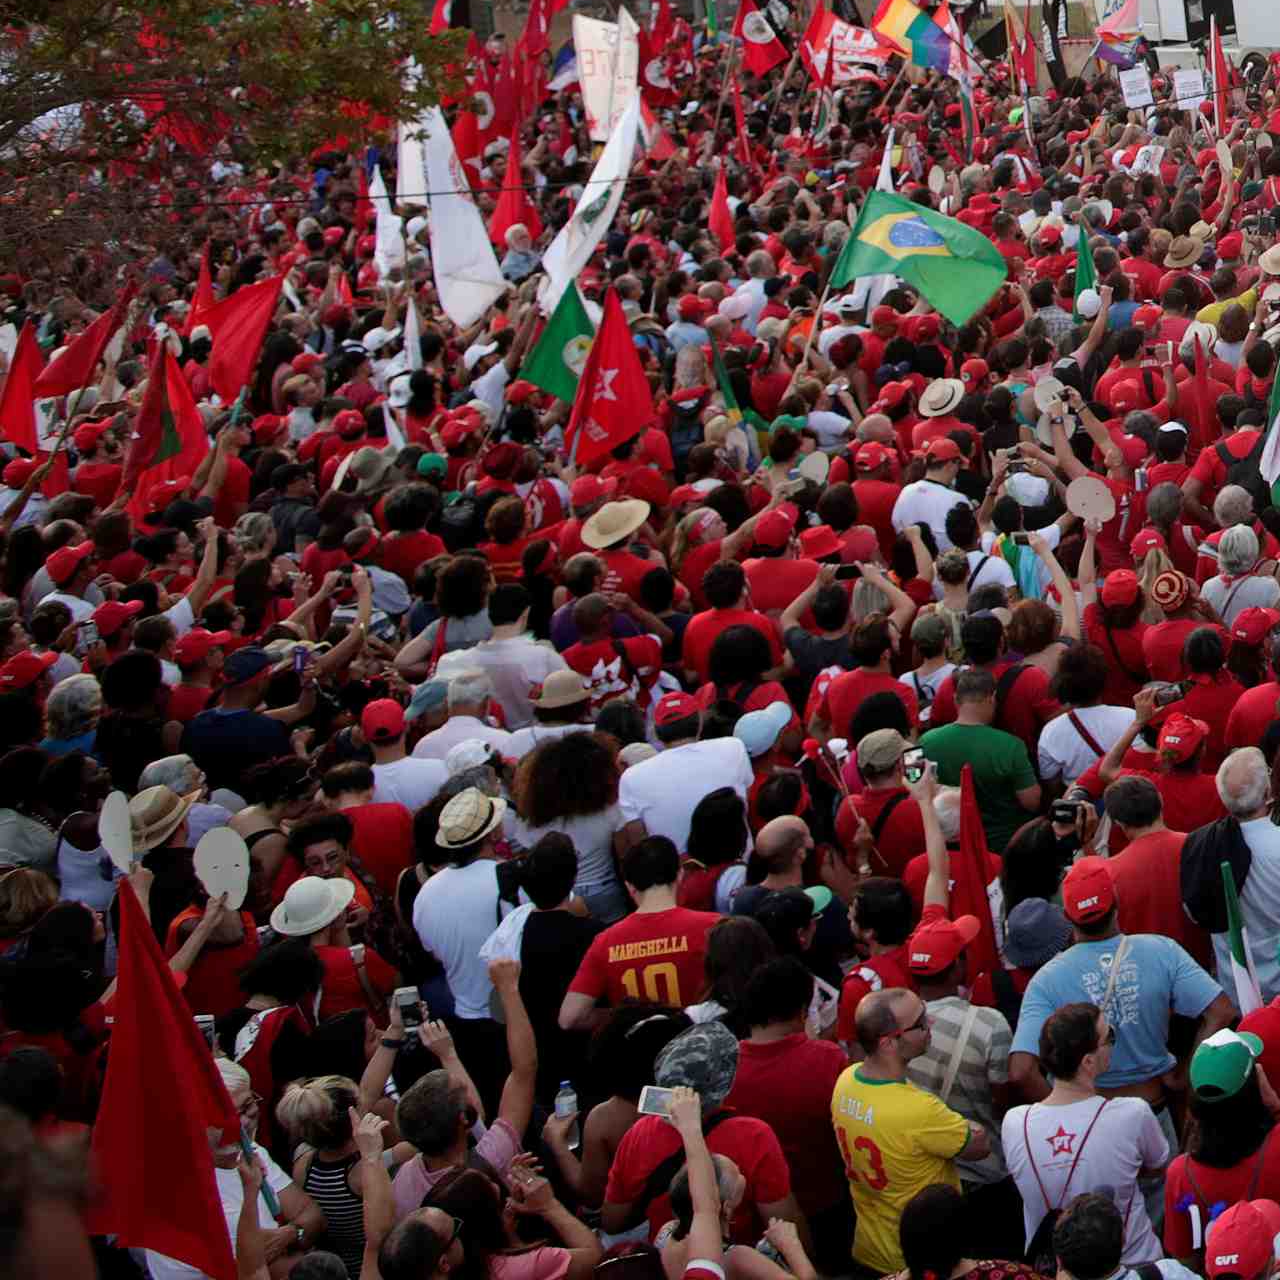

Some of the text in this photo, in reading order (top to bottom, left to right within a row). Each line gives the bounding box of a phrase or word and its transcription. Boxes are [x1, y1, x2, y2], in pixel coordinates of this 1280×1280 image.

[607, 935, 689, 963] MARIGHELLA
[621, 962, 682, 1009] 10
[840, 1093, 875, 1125] LULA
[836, 1124, 889, 1191] 13
[1053, 1135, 1068, 1150] PT
